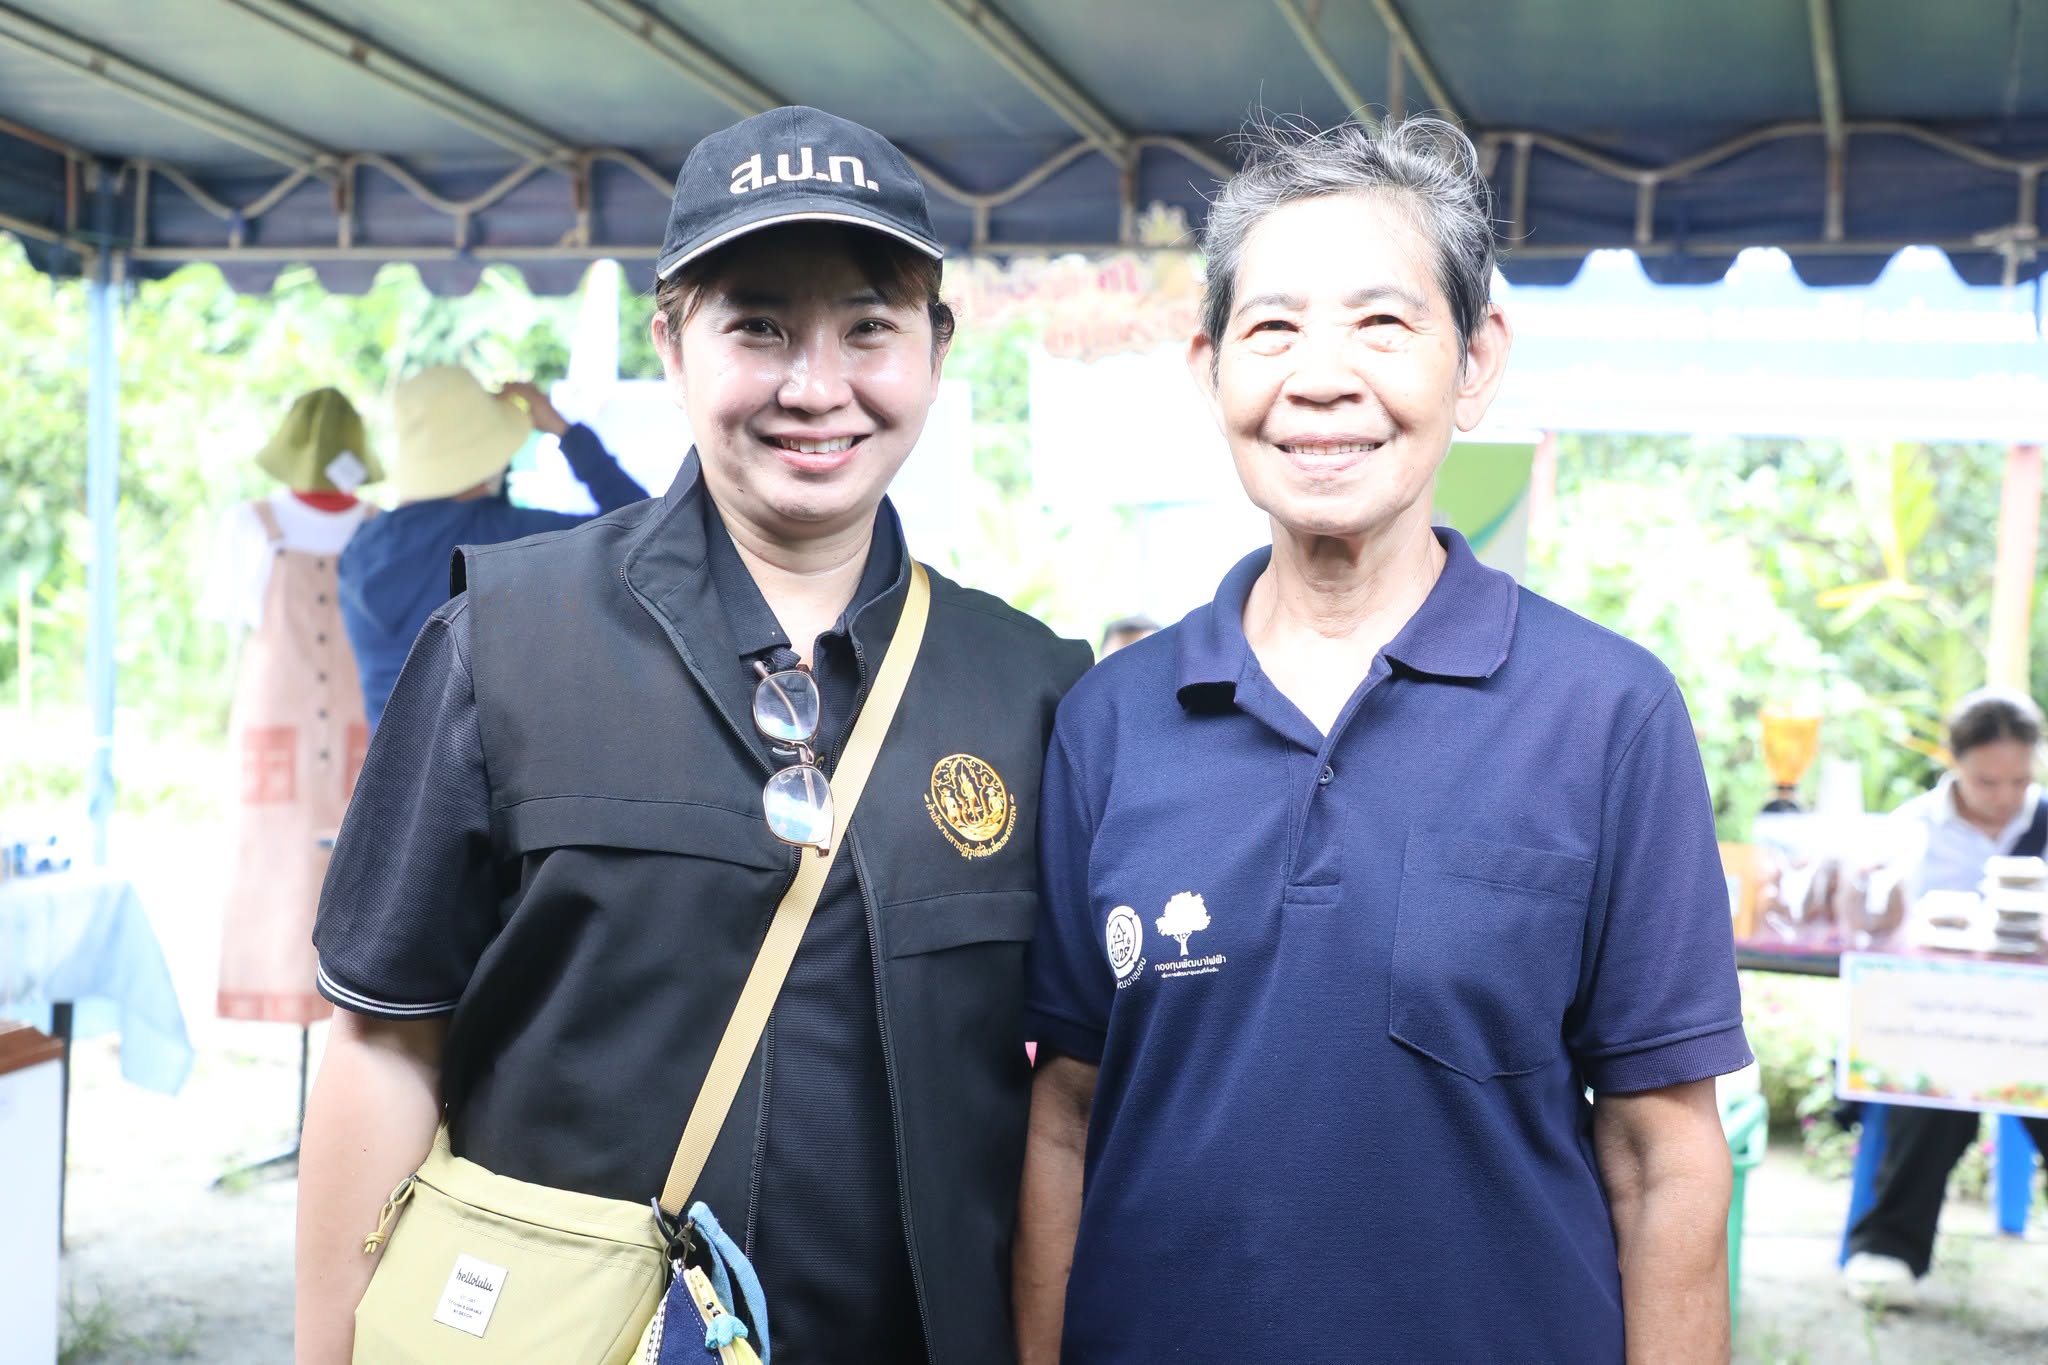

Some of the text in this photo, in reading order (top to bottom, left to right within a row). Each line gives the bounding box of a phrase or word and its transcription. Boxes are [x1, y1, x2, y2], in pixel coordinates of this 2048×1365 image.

[729, 147, 880, 195] ส.ป.ก.
[1154, 954, 1227, 972] กองทุนพัฒนาไฟฟ้า
[455, 1268, 494, 1292] hellolulu
